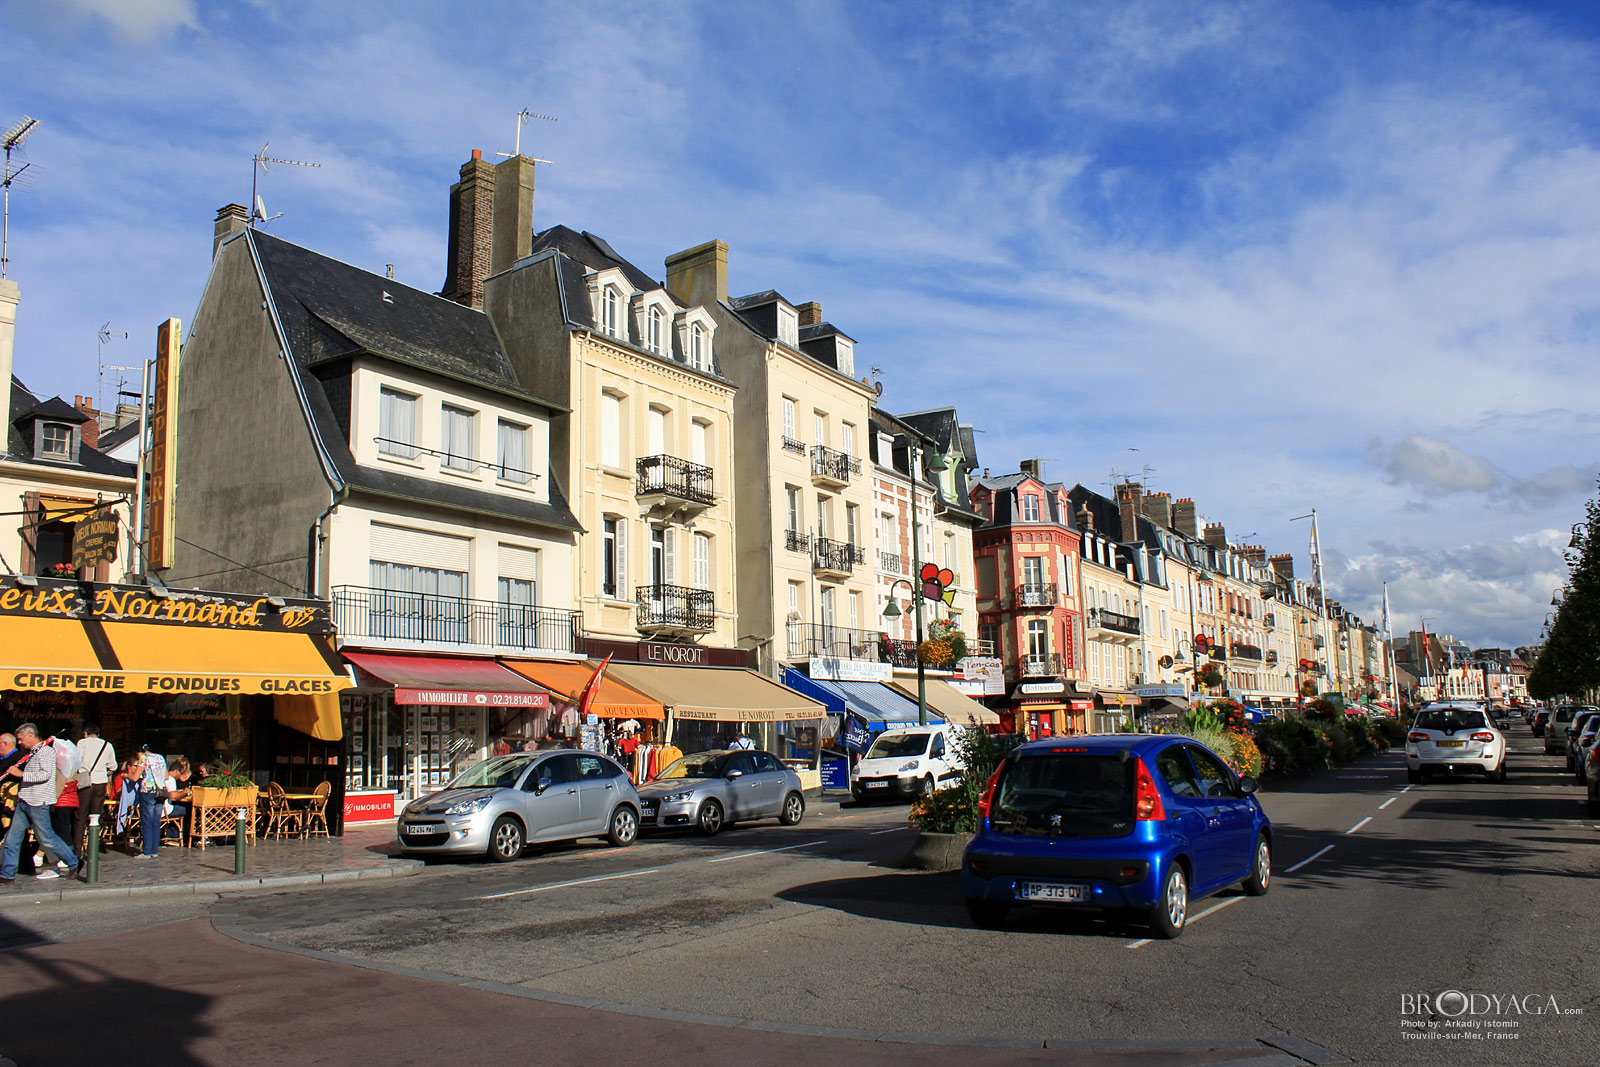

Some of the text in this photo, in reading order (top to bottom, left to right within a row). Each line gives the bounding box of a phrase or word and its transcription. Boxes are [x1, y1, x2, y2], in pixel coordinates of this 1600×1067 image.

[150, 326, 170, 564] CREPERIE
[90, 520, 116, 535] NORMAND
[0, 580, 267, 627] eux Normand
[1065, 615, 1073, 669] BOULANGERIE
[647, 645, 704, 664] LE NOROIT
[13, 673, 332, 692] CREPERIE FONDUES GLACES
[418, 692, 468, 704] IMMOBILIER
[604, 706, 649, 717] SOUVENIRS
[679, 710, 717, 720] RESTAURANT
[738, 711, 747, 721] LE
[748, 711, 776, 721] NOROIT
[353, 802, 392, 812] IMMOBILIER
